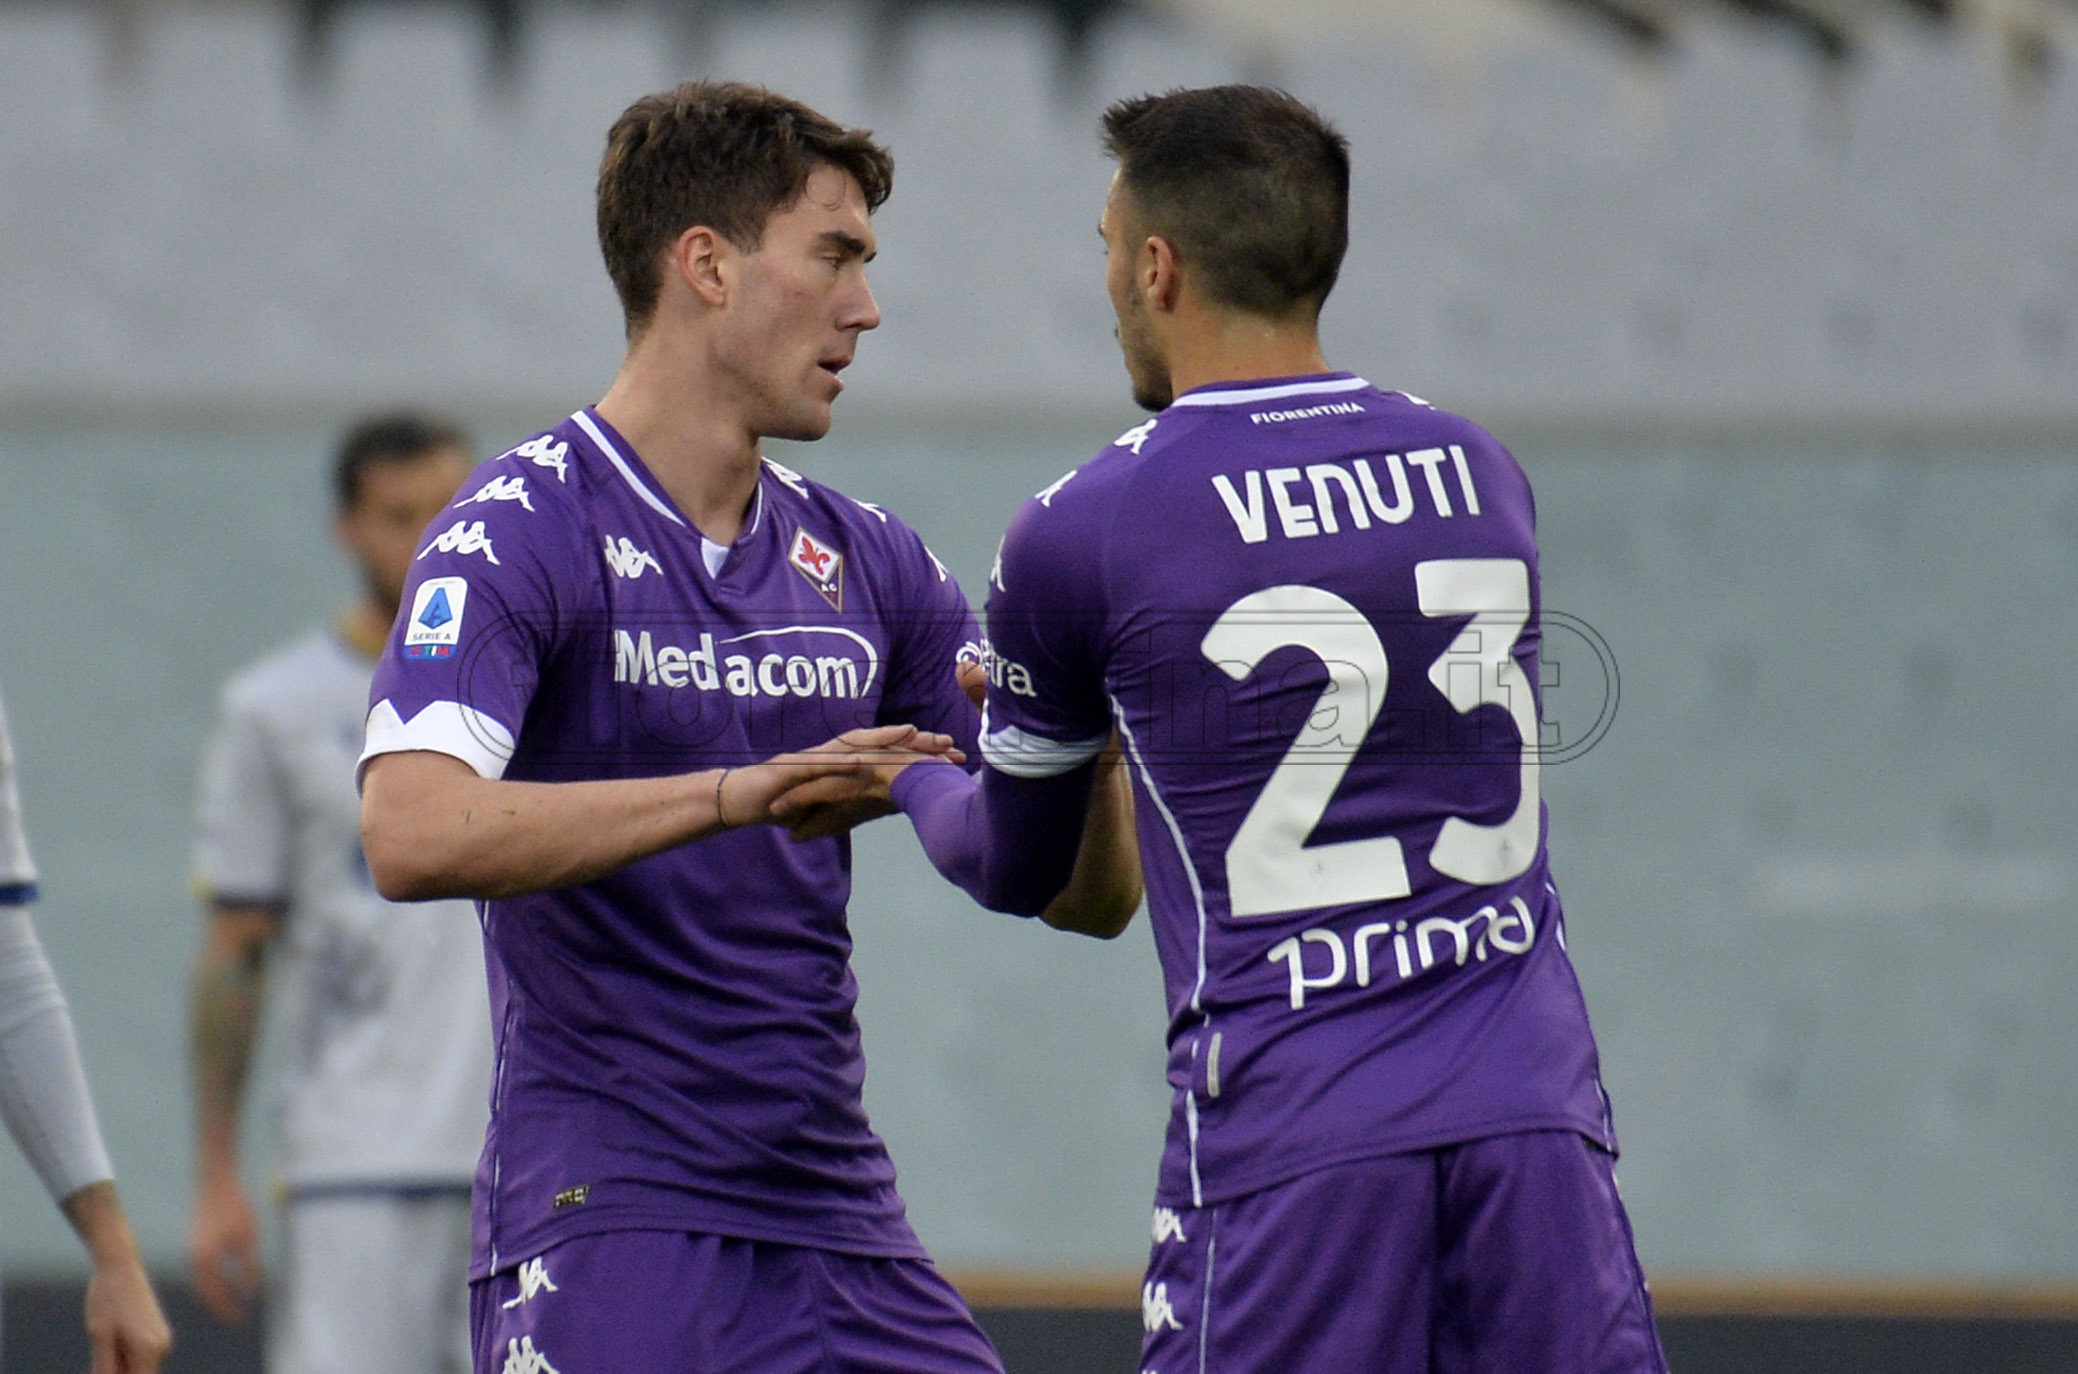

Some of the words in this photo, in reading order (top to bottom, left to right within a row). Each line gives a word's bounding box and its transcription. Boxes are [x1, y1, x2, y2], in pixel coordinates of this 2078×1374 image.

[1250, 402, 1366, 425] FIORENTINA
[1211, 445, 1481, 543] VENUTI
[412, 633, 441, 641] SERIE
[613, 629, 860, 699] Medacom
[1200, 559, 1541, 917] 23
[1267, 896, 1535, 1010] prima
